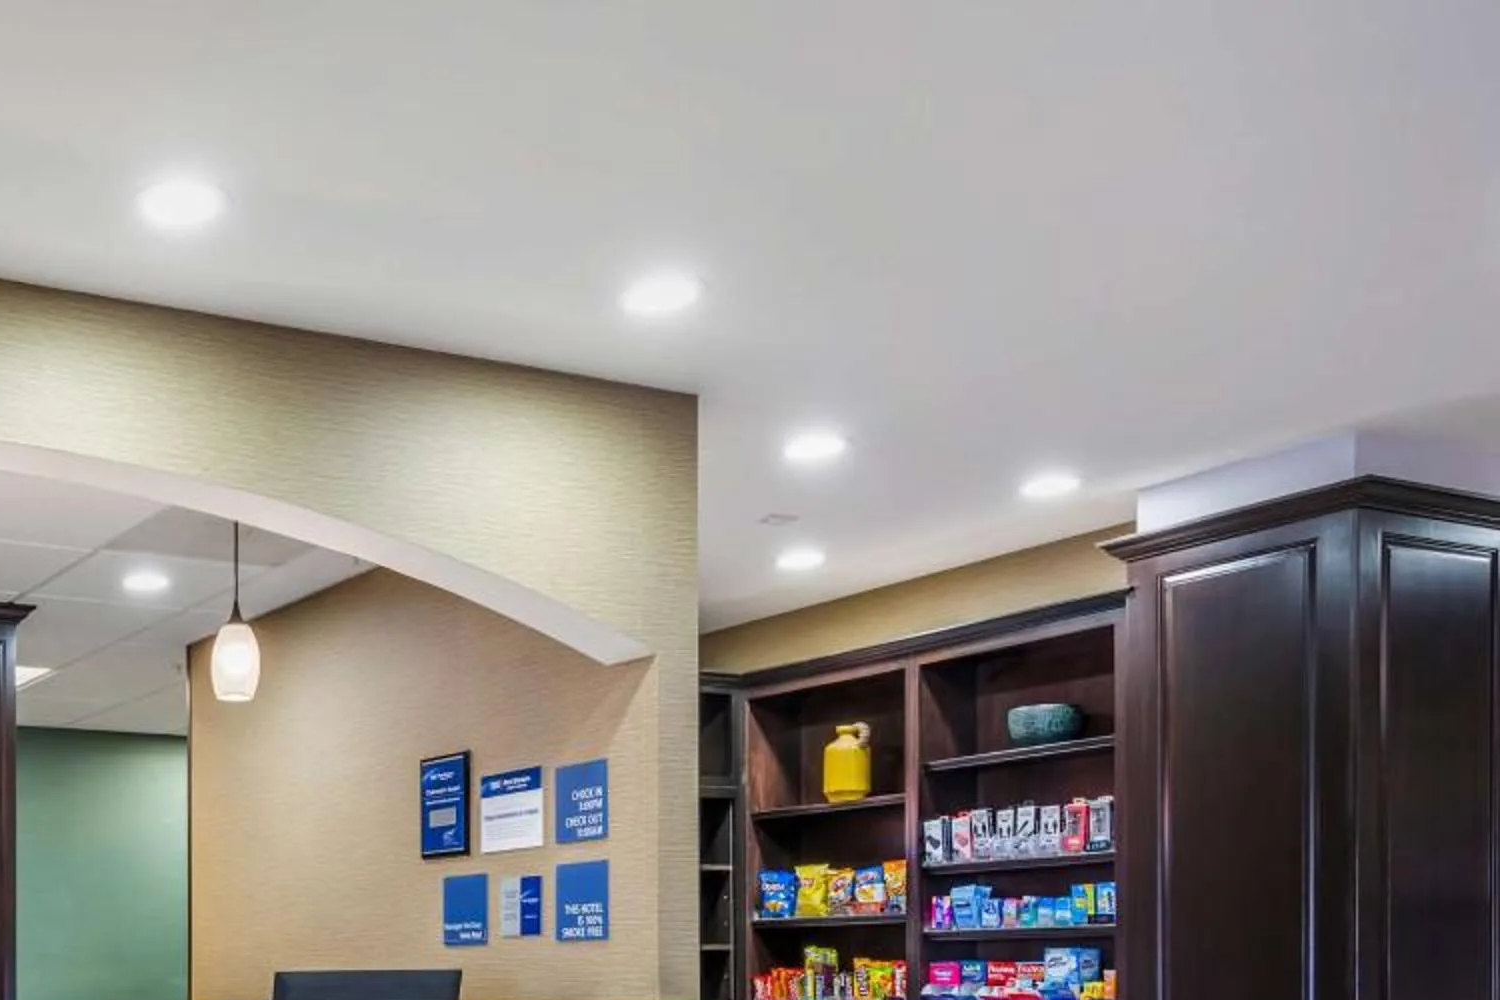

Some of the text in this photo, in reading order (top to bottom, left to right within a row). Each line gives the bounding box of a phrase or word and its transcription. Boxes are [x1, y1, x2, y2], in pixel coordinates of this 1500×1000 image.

[571, 787, 593, 801] CHECK
[565, 815, 587, 829] CHECK
[581, 902, 603, 914] HOTEL
